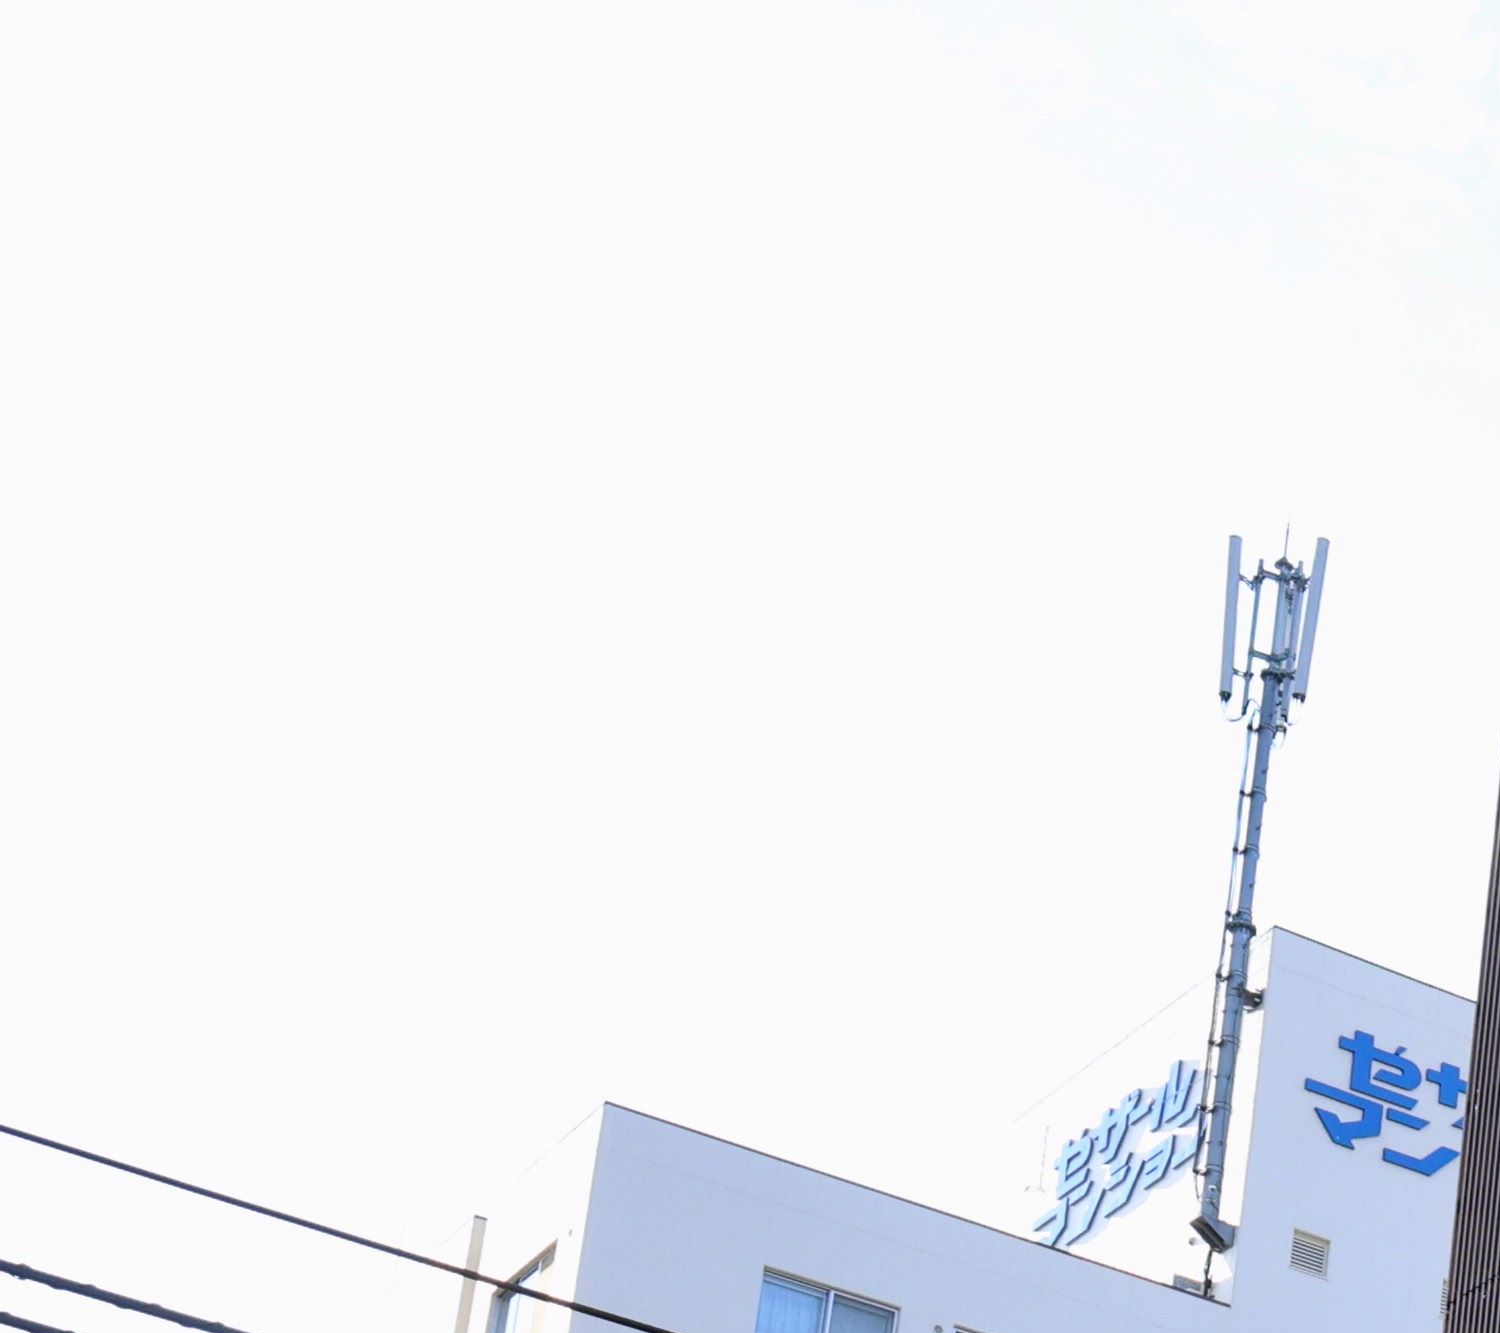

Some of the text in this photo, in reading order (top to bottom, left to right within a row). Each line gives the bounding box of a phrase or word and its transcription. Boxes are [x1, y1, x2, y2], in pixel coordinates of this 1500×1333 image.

[1056, 1060, 1202, 1198] セザール
[1304, 1078, 1464, 1177] マン
